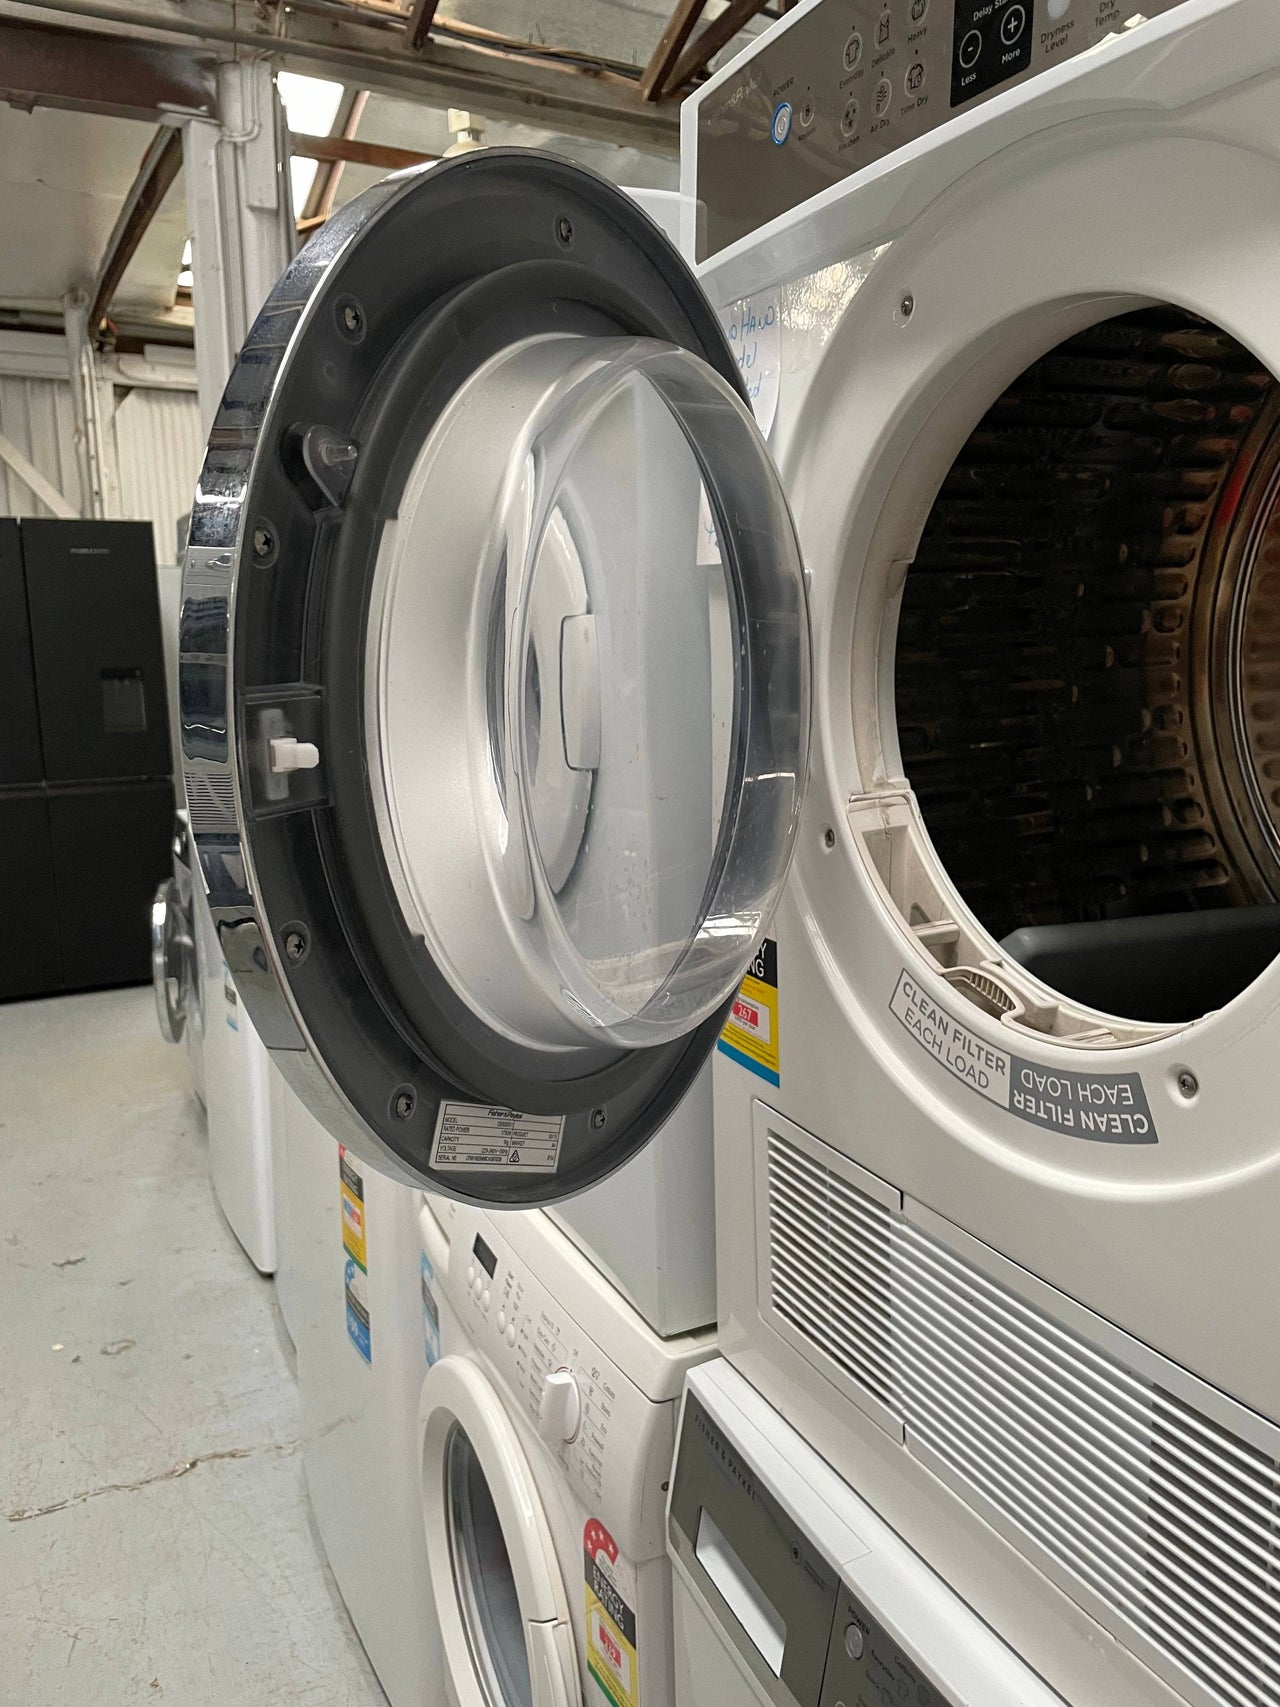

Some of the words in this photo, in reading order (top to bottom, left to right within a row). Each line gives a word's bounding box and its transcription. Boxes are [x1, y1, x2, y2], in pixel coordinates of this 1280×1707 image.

[973, 3, 993, 22] Delay
[1099, 0, 1115, 13] Dry
[1095, 10, 1120, 27] Temp
[908, 26, 928, 44] Heavy
[1040, 19, 1075, 44] Dryness
[1001, 47, 1021, 64] More
[1045, 36, 1068, 54] Level
[773, 76, 794, 98] POWER
[840, 69, 864, 90] Everyday
[961, 72, 977, 86] Less
[917, 95, 929, 107] Dry
[738, 1004, 752, 1021] 267
[903, 981, 949, 1036] CLEAN
[953, 1031, 1006, 1076] FILTER
[904, 1006, 943, 1055] EACH
[946, 1043, 990, 1089] LOAD
[1020, 1069, 1071, 1101] LOAD
[1078, 1082, 1134, 1106] EACH
[1013, 1089, 1074, 1127] FILTER
[1081, 1110, 1149, 1135] CLEAN
[694, 1413, 720, 1452] FISHER
[727, 1458, 756, 1500] PAYKEL
[848, 1604, 870, 1635] POWER
